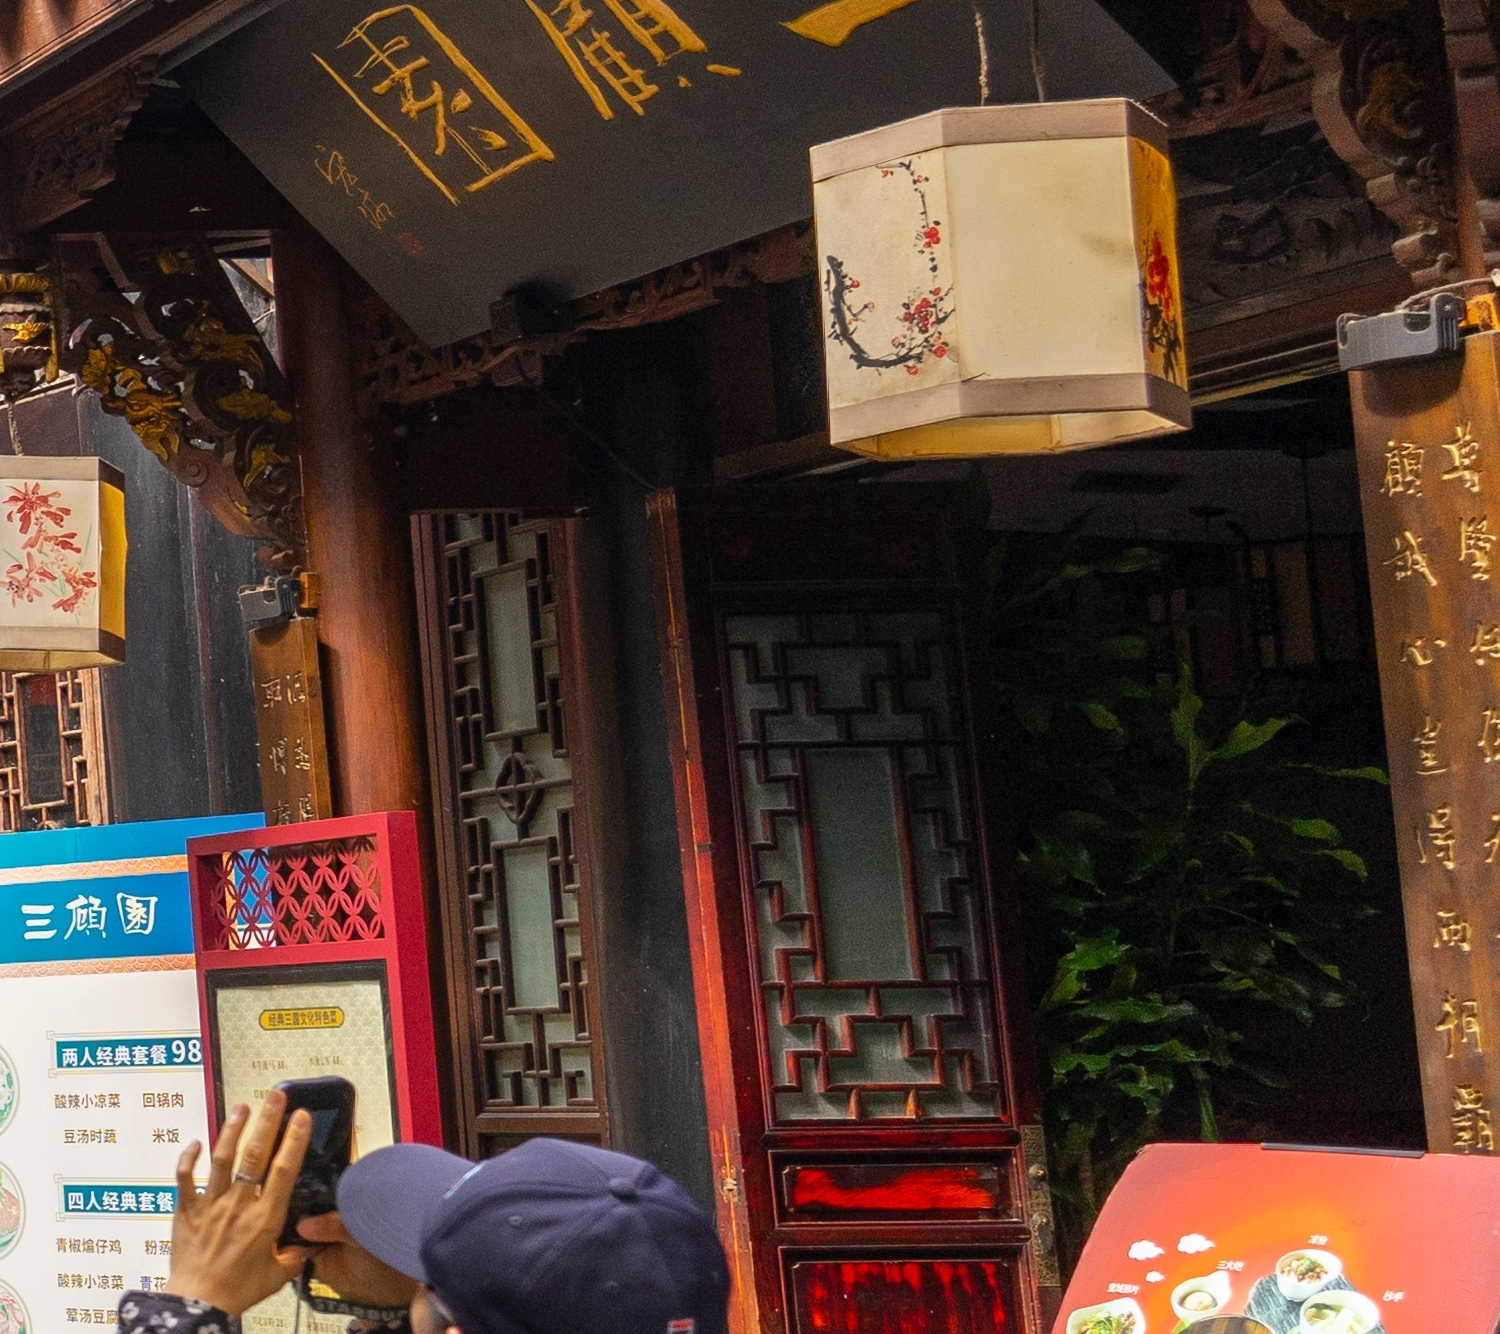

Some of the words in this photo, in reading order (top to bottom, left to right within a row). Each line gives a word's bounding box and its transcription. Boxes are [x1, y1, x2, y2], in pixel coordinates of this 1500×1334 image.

[62, 1045, 167, 1067] 两人经典套餐
[172, 1040, 202, 1063] 98
[54, 1093, 121, 1109] 酸辣小凉菜
[143, 1093, 184, 1108] 回锅肉
[64, 1129, 117, 1144] 豆汤时蔬
[153, 1129, 180, 1143] 米饭
[68, 1191, 174, 1212] 四人经典套餐
[58, 1274, 124, 1290] 酸辣小凉菜
